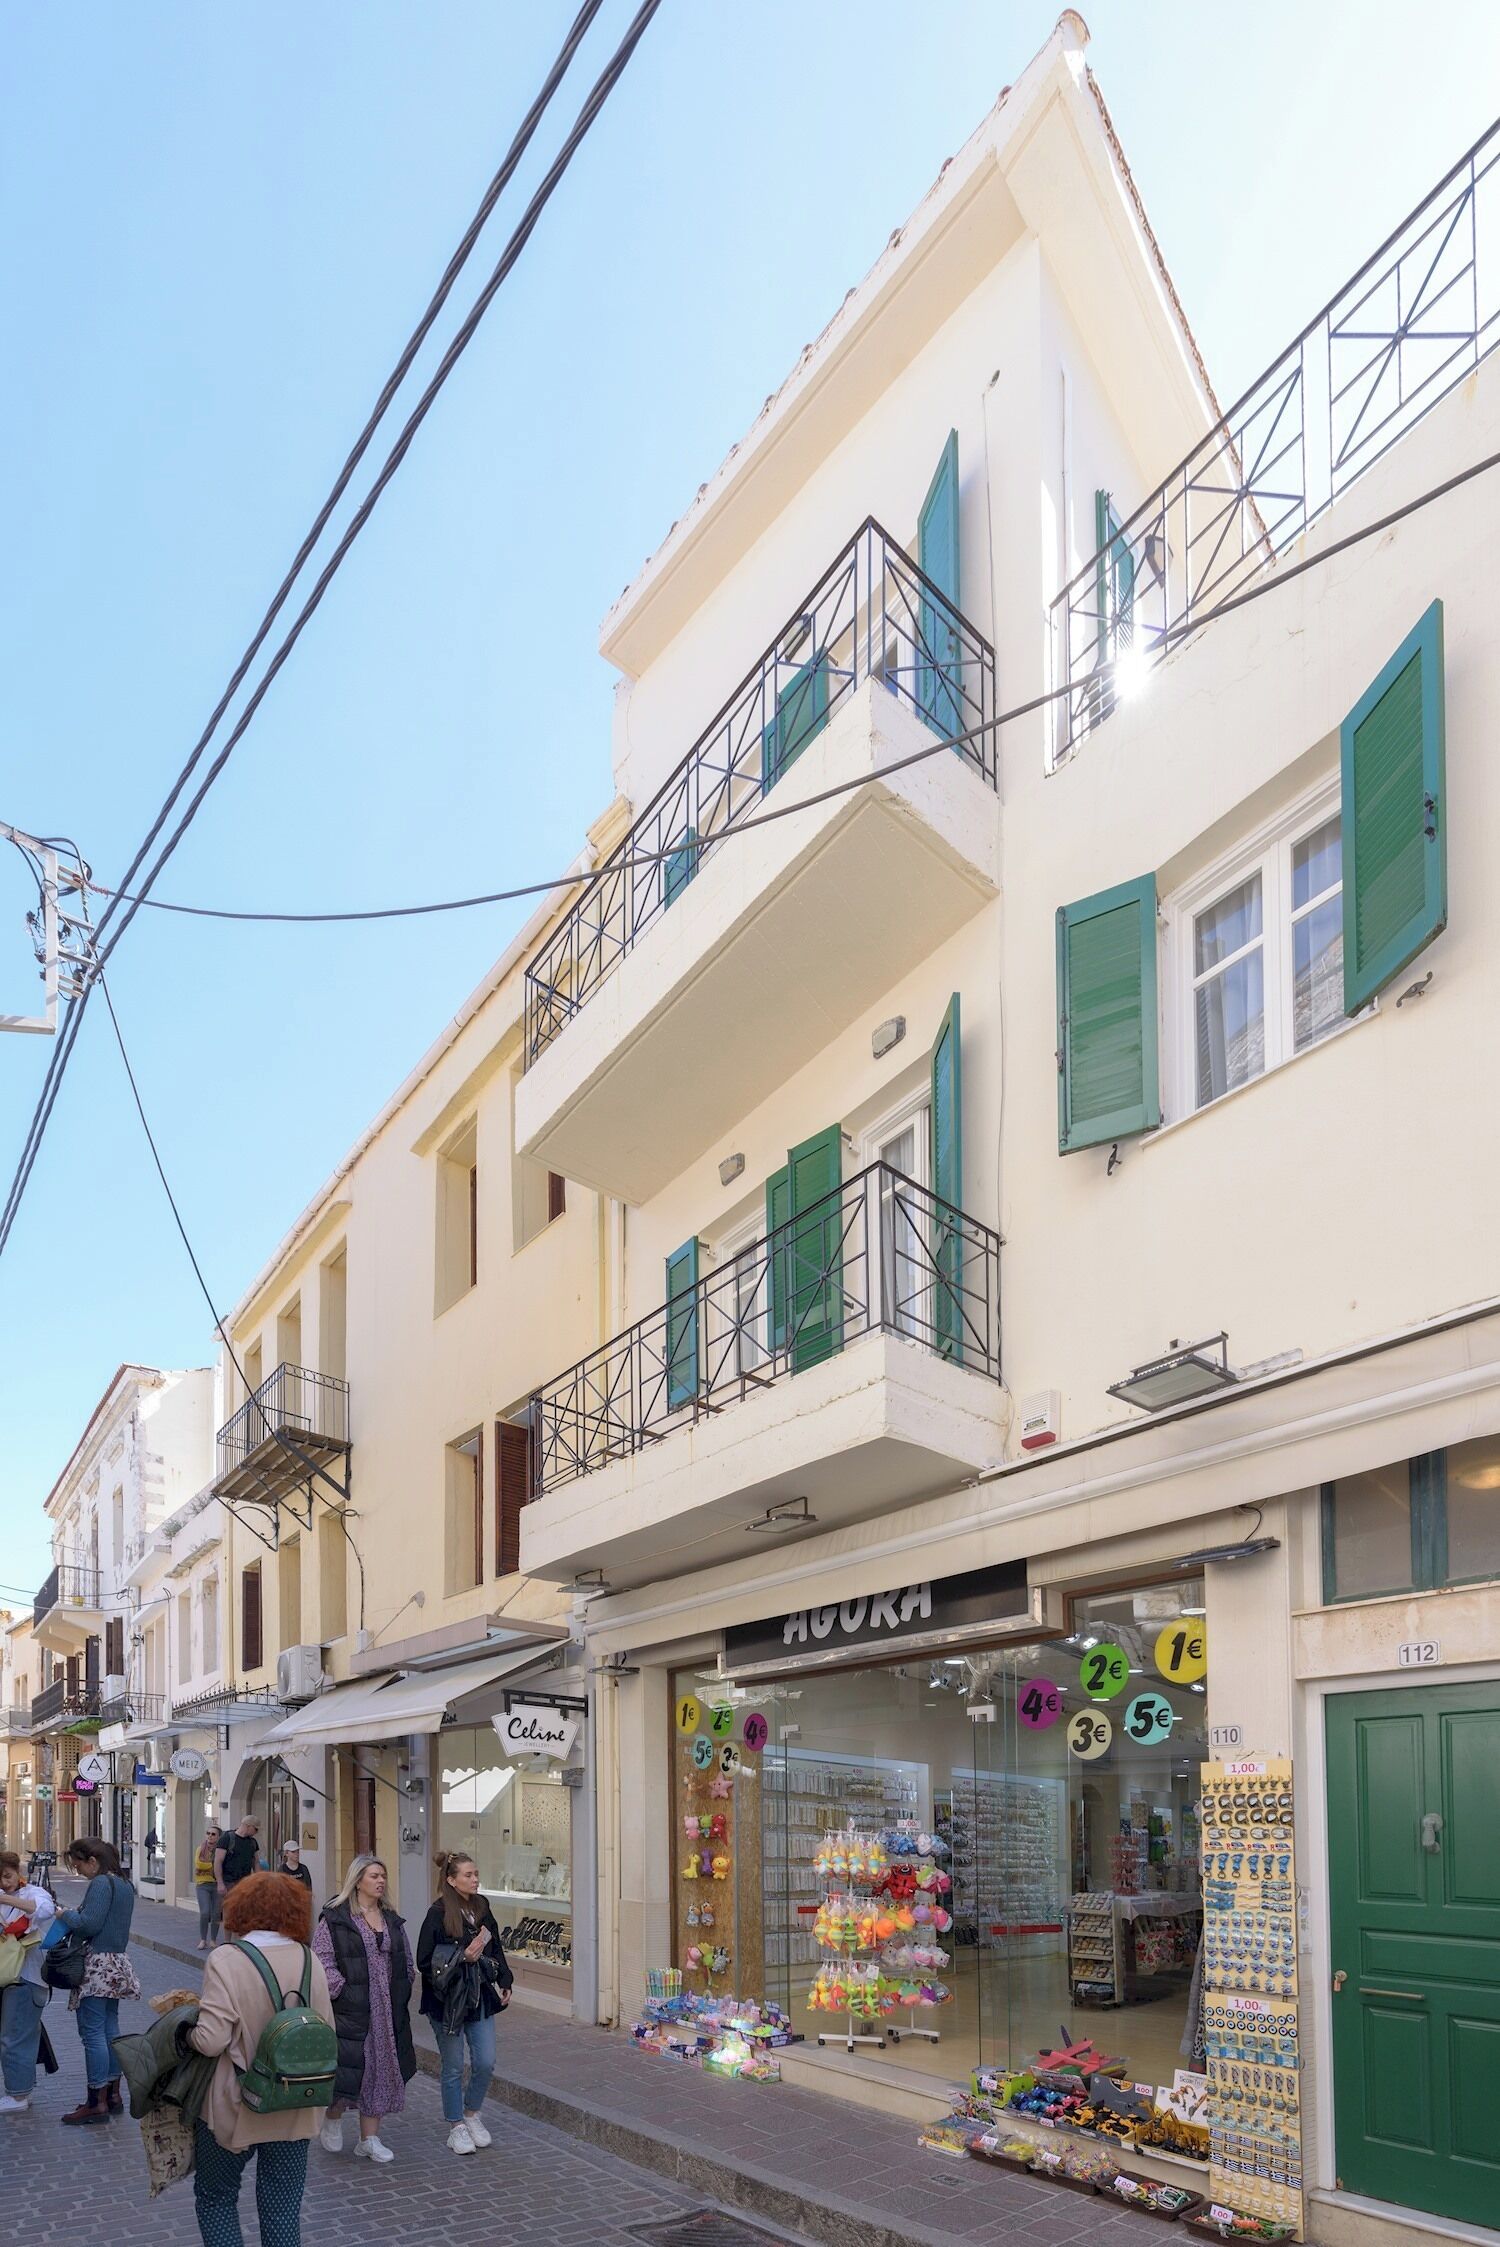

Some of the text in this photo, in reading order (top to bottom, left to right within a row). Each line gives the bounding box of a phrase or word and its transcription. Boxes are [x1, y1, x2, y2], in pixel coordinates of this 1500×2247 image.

[783, 1581, 932, 1645] AGORA
[1170, 1631, 1203, 1671] 1€
[1402, 1644, 1434, 1663] 112
[1086, 1654, 1122, 1691] 2€
[682, 1703, 694, 1727] 1€
[1021, 1688, 1057, 1722] 4€
[507, 1717, 565, 1741] Celine
[1130, 1700, 1170, 1738] 5€
[745, 1720, 767, 1745] 4€
[1072, 1716, 1106, 1752] 3€
[1213, 1728, 1238, 1743] 110
[695, 1740, 712, 1764] 5€
[179, 1761, 199, 1769] MEIZ
